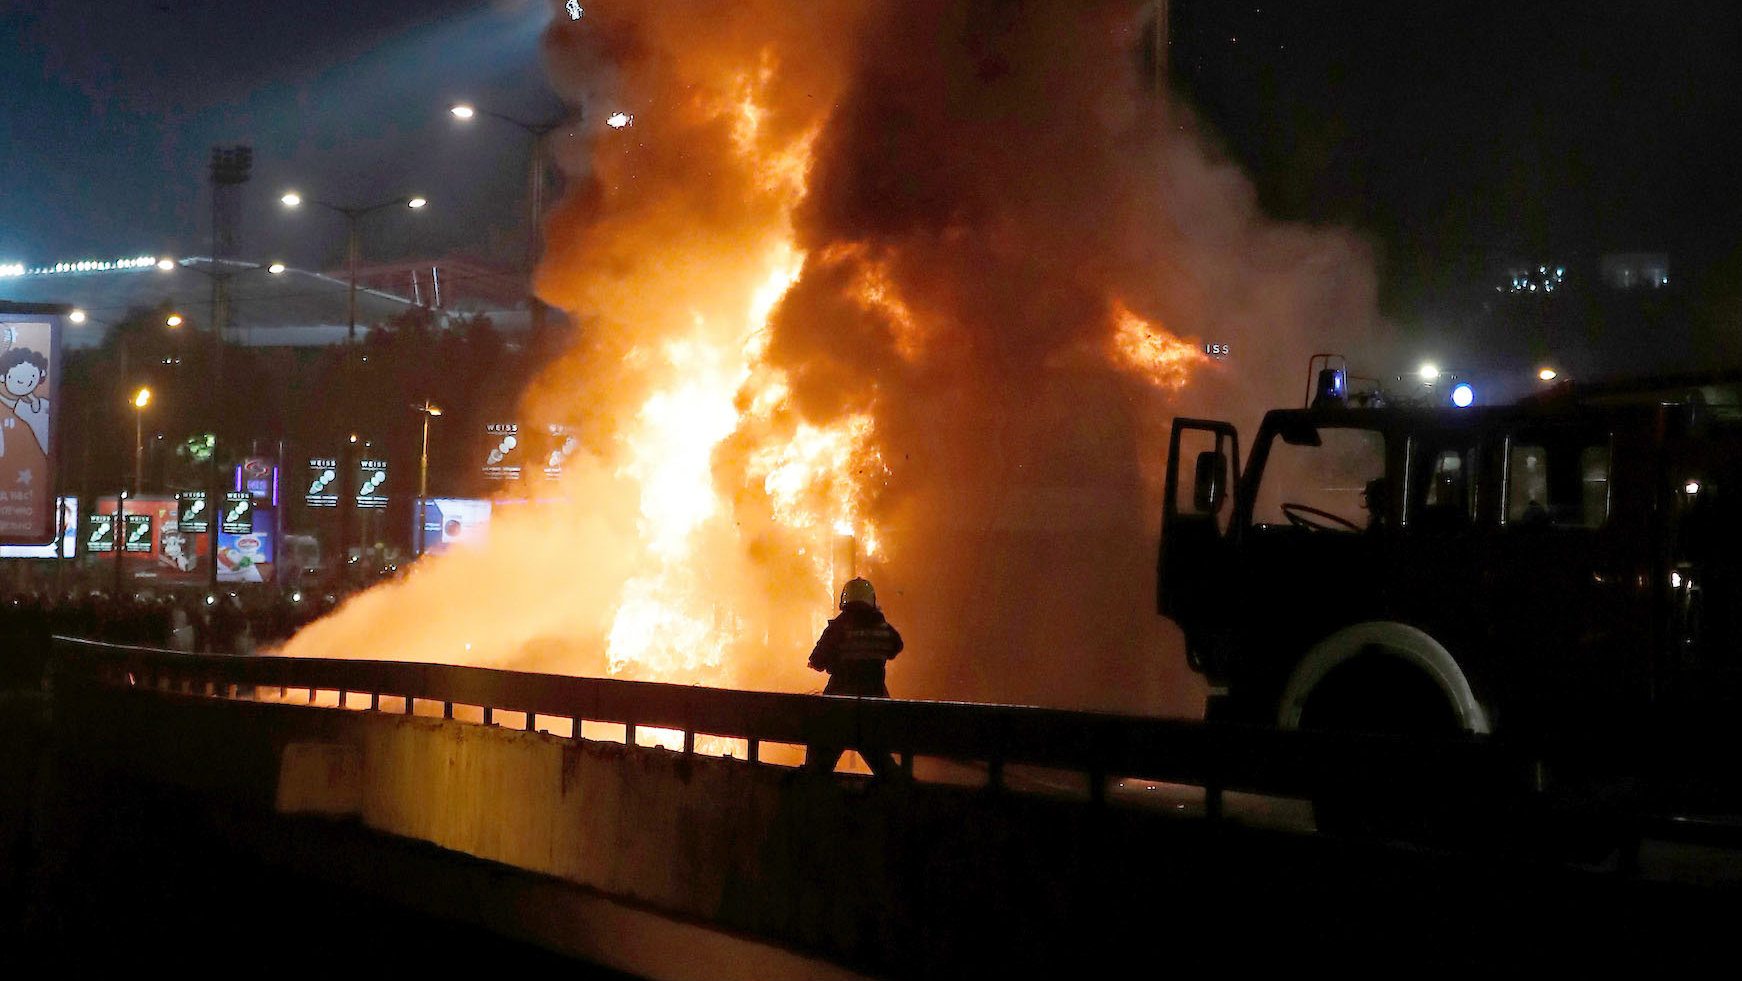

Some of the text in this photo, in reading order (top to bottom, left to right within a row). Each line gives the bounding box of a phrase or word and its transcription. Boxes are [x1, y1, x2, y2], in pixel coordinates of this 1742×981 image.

[1206, 343, 1229, 355] ISS
[487, 424, 518, 432] WEISS
[361, 460, 387, 468] WEISS
